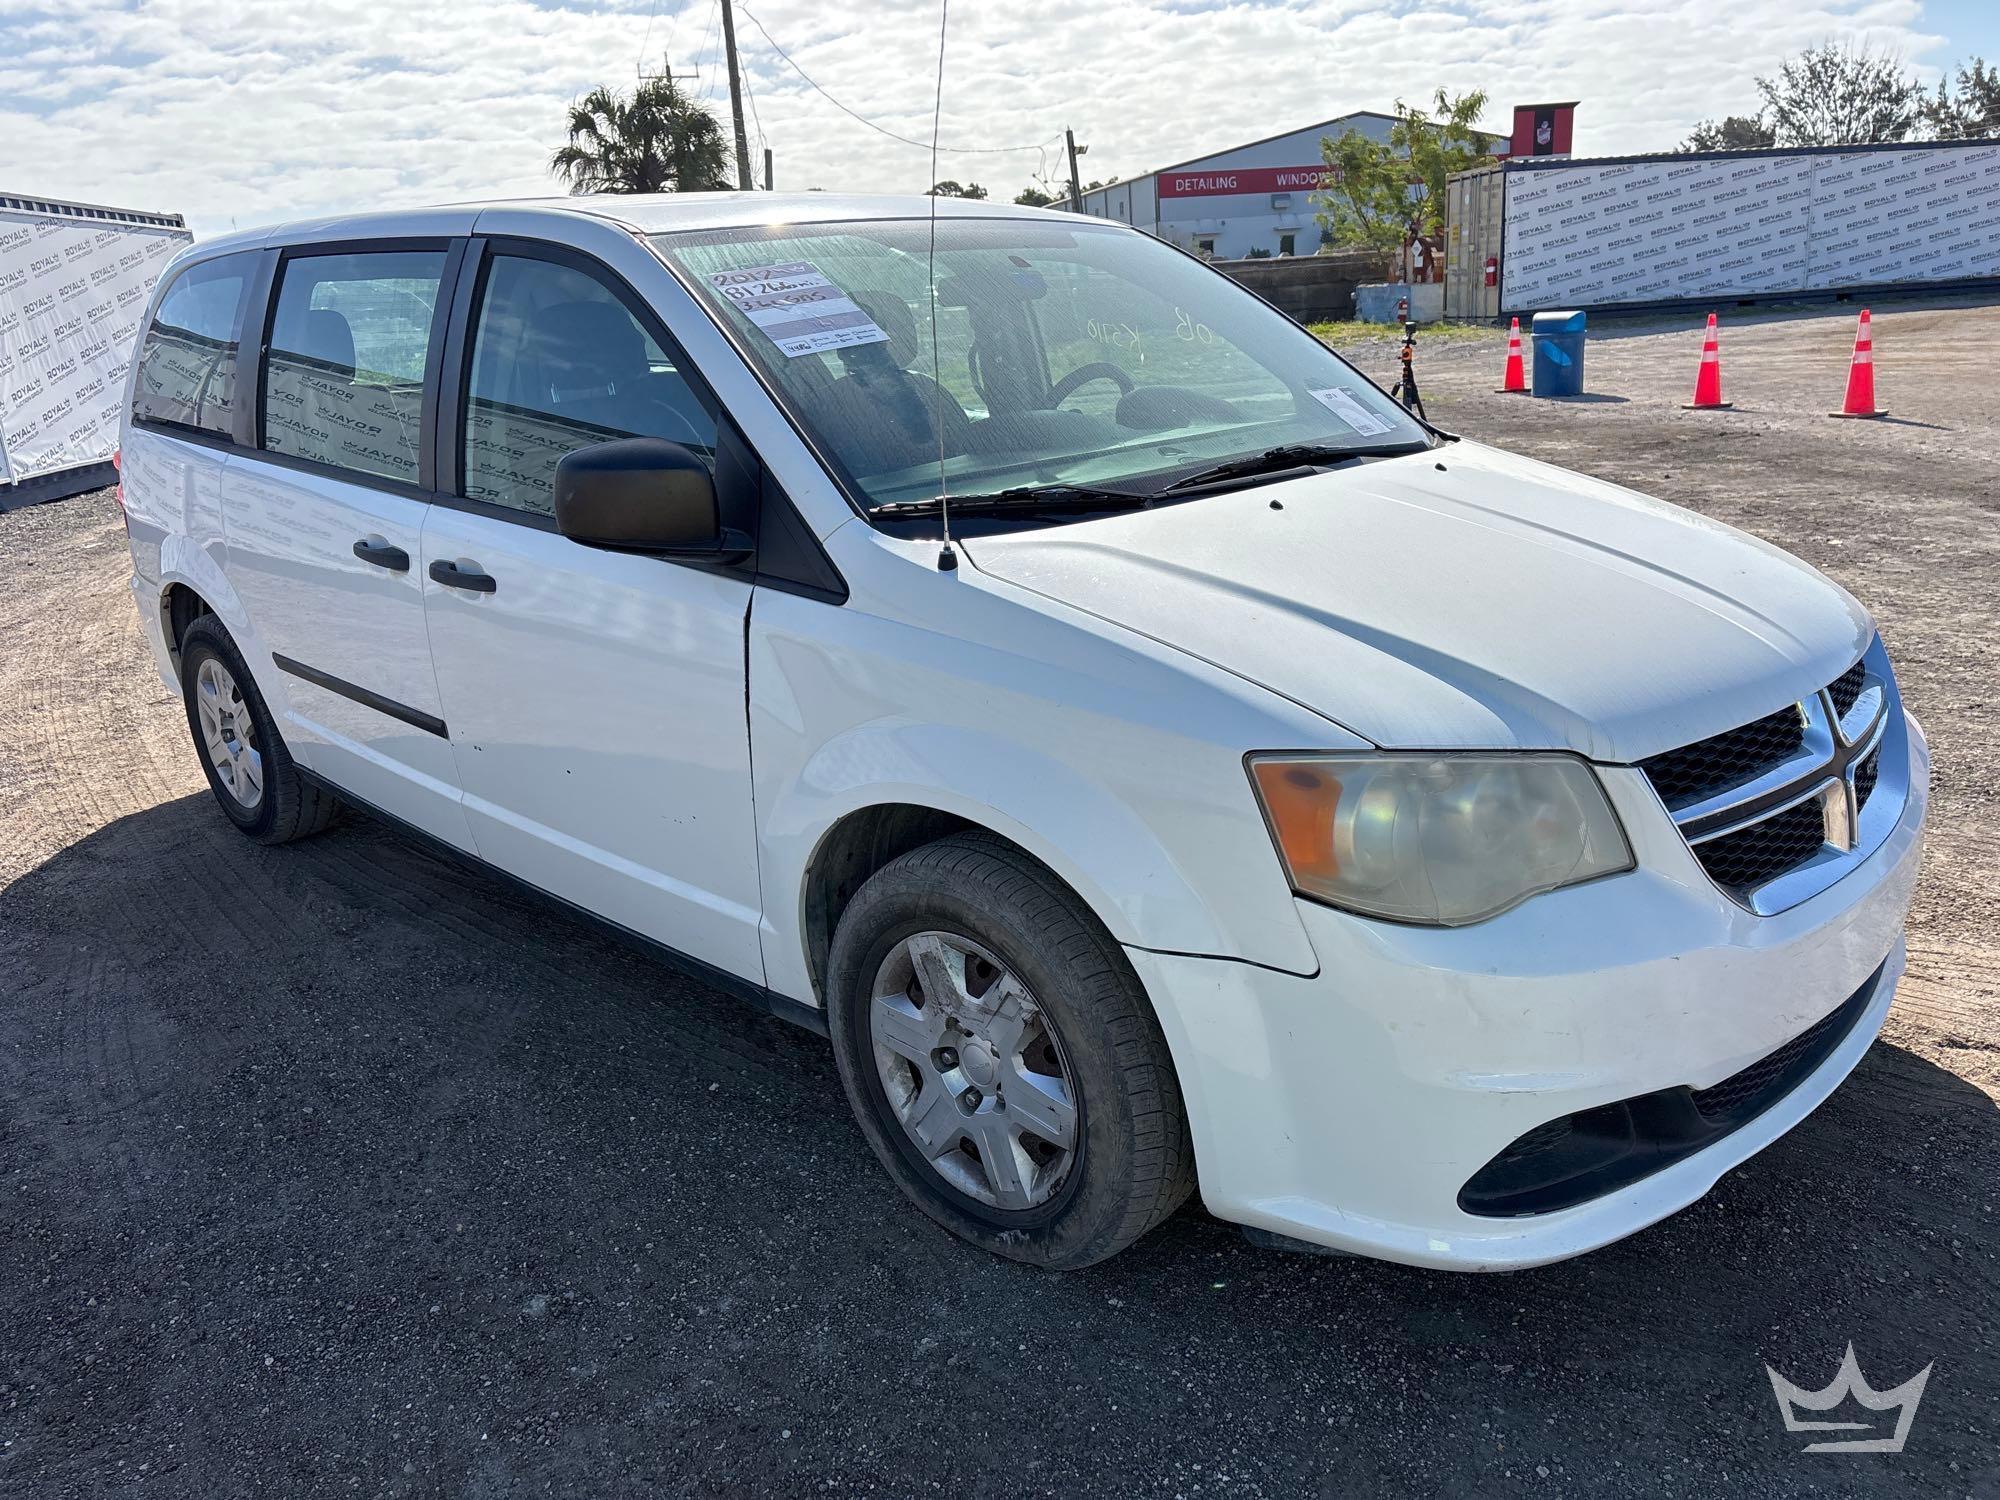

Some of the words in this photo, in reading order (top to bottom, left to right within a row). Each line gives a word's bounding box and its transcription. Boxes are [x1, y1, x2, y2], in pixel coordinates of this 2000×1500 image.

[1902, 152, 1926, 161] ROYAL
[1965, 151, 1989, 162] ROYAL
[1600, 166, 1626, 178] ROYAL
[1668, 166, 1694, 178] ROYAL
[1732, 167, 1757, 178] ROYAL
[1861, 163, 1886, 172] ROYAL
[1925, 162, 1949, 173] ROYAL
[1175, 177, 1237, 191] DETAILING
[1556, 178, 1584, 190] ROYAL
[1625, 179, 1650, 189] ROYAL
[1690, 179, 1715, 189] ROYAL
[1756, 179, 1781, 189] ROYAL
[1820, 173, 1845, 184] ROYAL
[1885, 173, 1910, 184] ROYAL
[1944, 175, 1970, 184] ROYAL
[1582, 190, 1608, 201] ROYAL
[1647, 190, 1673, 201] ROYAL
[1714, 190, 1740, 201] ROYAL
[1777, 190, 1803, 201] ROYAL
[1844, 185, 1868, 195] ROYAL
[1905, 186, 1929, 195] ROYAL
[1967, 185, 1992, 195] ROYAL
[1513, 190, 1540, 202] ROYAL
[1864, 196, 1889, 207] ROYAL
[1927, 196, 1951, 207] ROYAL
[1538, 202, 1564, 213] ROYAL
[1604, 202, 1630, 213] ROYAL
[1672, 202, 1698, 212] ROYAL
[1735, 202, 1761, 212] ROYAL
[1824, 207, 1848, 218] ROYAL
[1629, 213, 1654, 224] ROYAL
[1888, 208, 1912, 218] ROYAL
[1946, 208, 1972, 218] ROYAL
[1560, 214, 1587, 225] ROYAL
[1693, 214, 1718, 224] ROYAL
[1759, 214, 1784, 224] ROYAL
[1847, 218, 1872, 229] ROYAL
[1907, 219, 1932, 229] ROYAL
[1969, 219, 1995, 229] ROYAL
[1518, 226, 1544, 237] ROYAL
[1586, 224, 1611, 236] ROYAL
[1651, 225, 1676, 236] ROYAL
[1716, 225, 1742, 236] ROYAL
[1780, 224, 1806, 235] ROYAL
[1929, 230, 1953, 240] ROYAL
[1867, 230, 1892, 241] ROYAL
[146, 240, 163, 254] ROYAL
[1542, 237, 1569, 248] ROYAL
[1608, 237, 1634, 248] ROYAL
[1675, 236, 1701, 247] ROYAL
[1738, 237, 1763, 247] ROYAL
[1827, 241, 1852, 252] ROYAL
[1890, 240, 1914, 251] ROYAL
[1949, 241, 1974, 251] ROYAL
[64, 242, 86, 258] ROYAL
[1565, 248, 1591, 260] ROYAL
[1633, 248, 1658, 258] ROYAL
[1696, 248, 1722, 259] ROYAL
[1761, 248, 1787, 257] ROYAL
[120, 253, 138, 268] ROYAL
[1849, 252, 1874, 262] ROYAL
[1910, 252, 1935, 262] ROYAL
[1971, 252, 1996, 262] ROYAL
[30, 256, 52, 272] ROYAL
[1522, 260, 1549, 272] ROYAL
[1591, 259, 1615, 270] ROYAL
[1654, 259, 1680, 270] ROYAL
[1720, 259, 1745, 269] ROYAL
[1808, 264, 1834, 273] ROYAL
[1870, 263, 1895, 273] ROYAL
[1932, 263, 1956, 272] ROYAL
[90, 266, 111, 281] ROYAL
[714, 269, 771, 285] 2012
[1547, 271, 1573, 282] ROYAL
[1612, 271, 1638, 282] ROYAL
[1678, 270, 1704, 281] ROYAL
[1741, 271, 1766, 280] ROYAL
[1829, 274, 1854, 284] ROYAL
[58, 280, 81, 298] ROYAL
[1570, 283, 1595, 294] ROYAL
[1636, 282, 1662, 293] ROYAL
[1700, 282, 1725, 292] ROYAL
[1764, 281, 1791, 290] ROYAL
[116, 288, 136, 303] ROYAL
[1527, 294, 1553, 306] ROYAL
[1593, 293, 1621, 304] ROYAL
[23, 298, 46, 315] ROYAL
[86, 303, 107, 319] ROYAL
[54, 320, 76, 338] ROYAL
[112, 326, 130, 342] ROYAL
[18, 338, 42, 357] ROYAL
[80, 342, 102, 360] ROYAL
[46, 361, 70, 380] ROYAL
[108, 362, 129, 380] ROYAL
[11, 383, 35, 403] ROYAL
[76, 382, 98, 400] ROYAL
[42, 404, 65, 423] ROYAL
[101, 400, 122, 420] ROYAL
[7, 426, 32, 447] ROYAL
[69, 424, 92, 443] ROYAL
[35, 447, 57, 468] ROYAL
